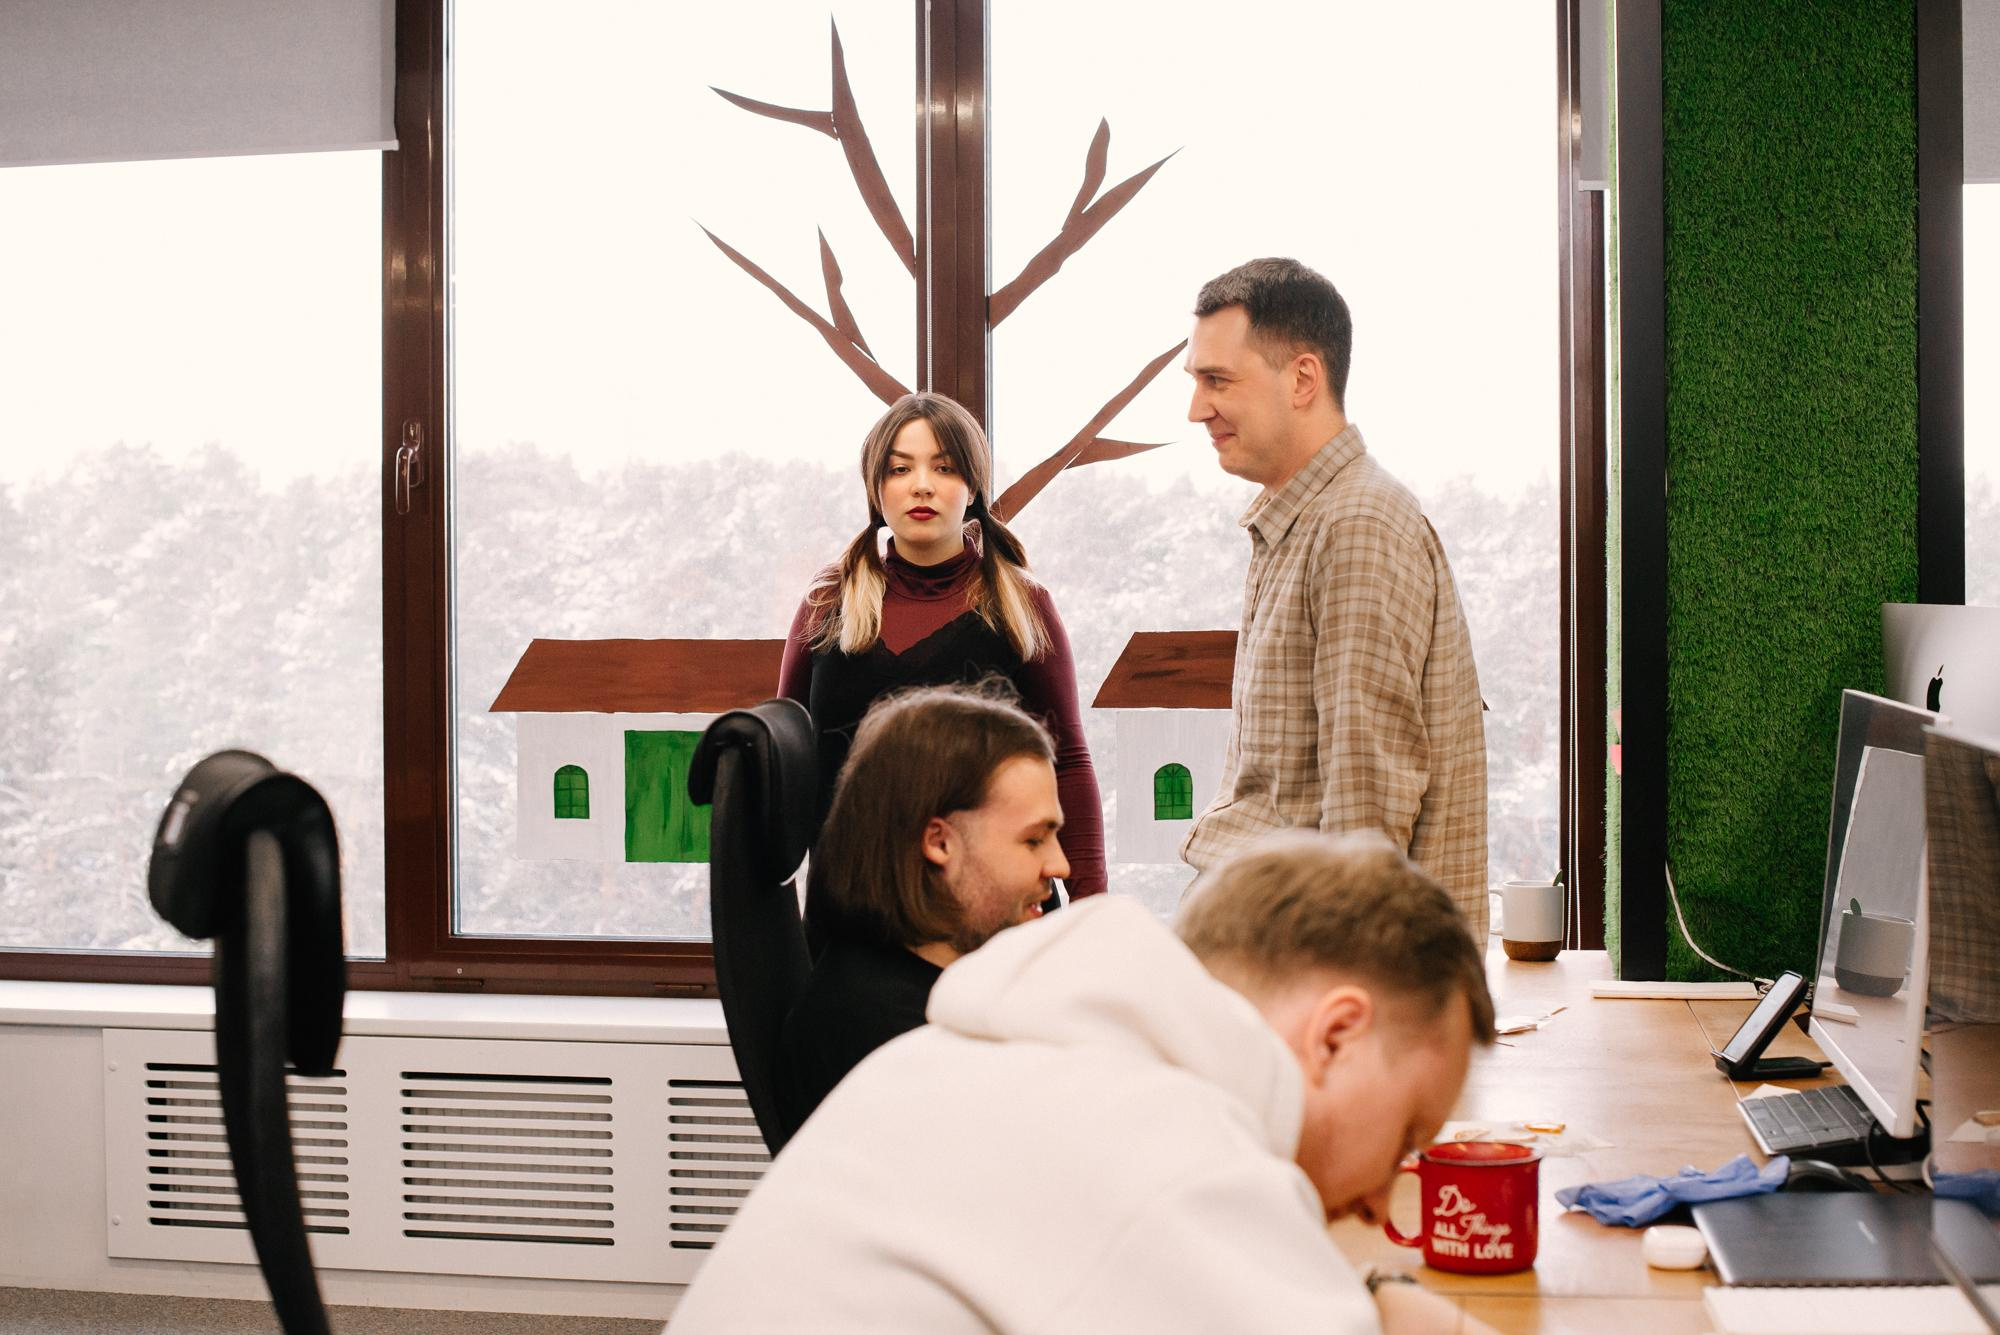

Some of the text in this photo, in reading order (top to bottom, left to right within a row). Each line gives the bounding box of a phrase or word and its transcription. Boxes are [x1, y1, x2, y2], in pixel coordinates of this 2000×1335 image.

[1433, 1185, 1476, 1217] Do
[1434, 1221, 1458, 1238] ALL
[1432, 1237, 1514, 1259] WITH LOVE
